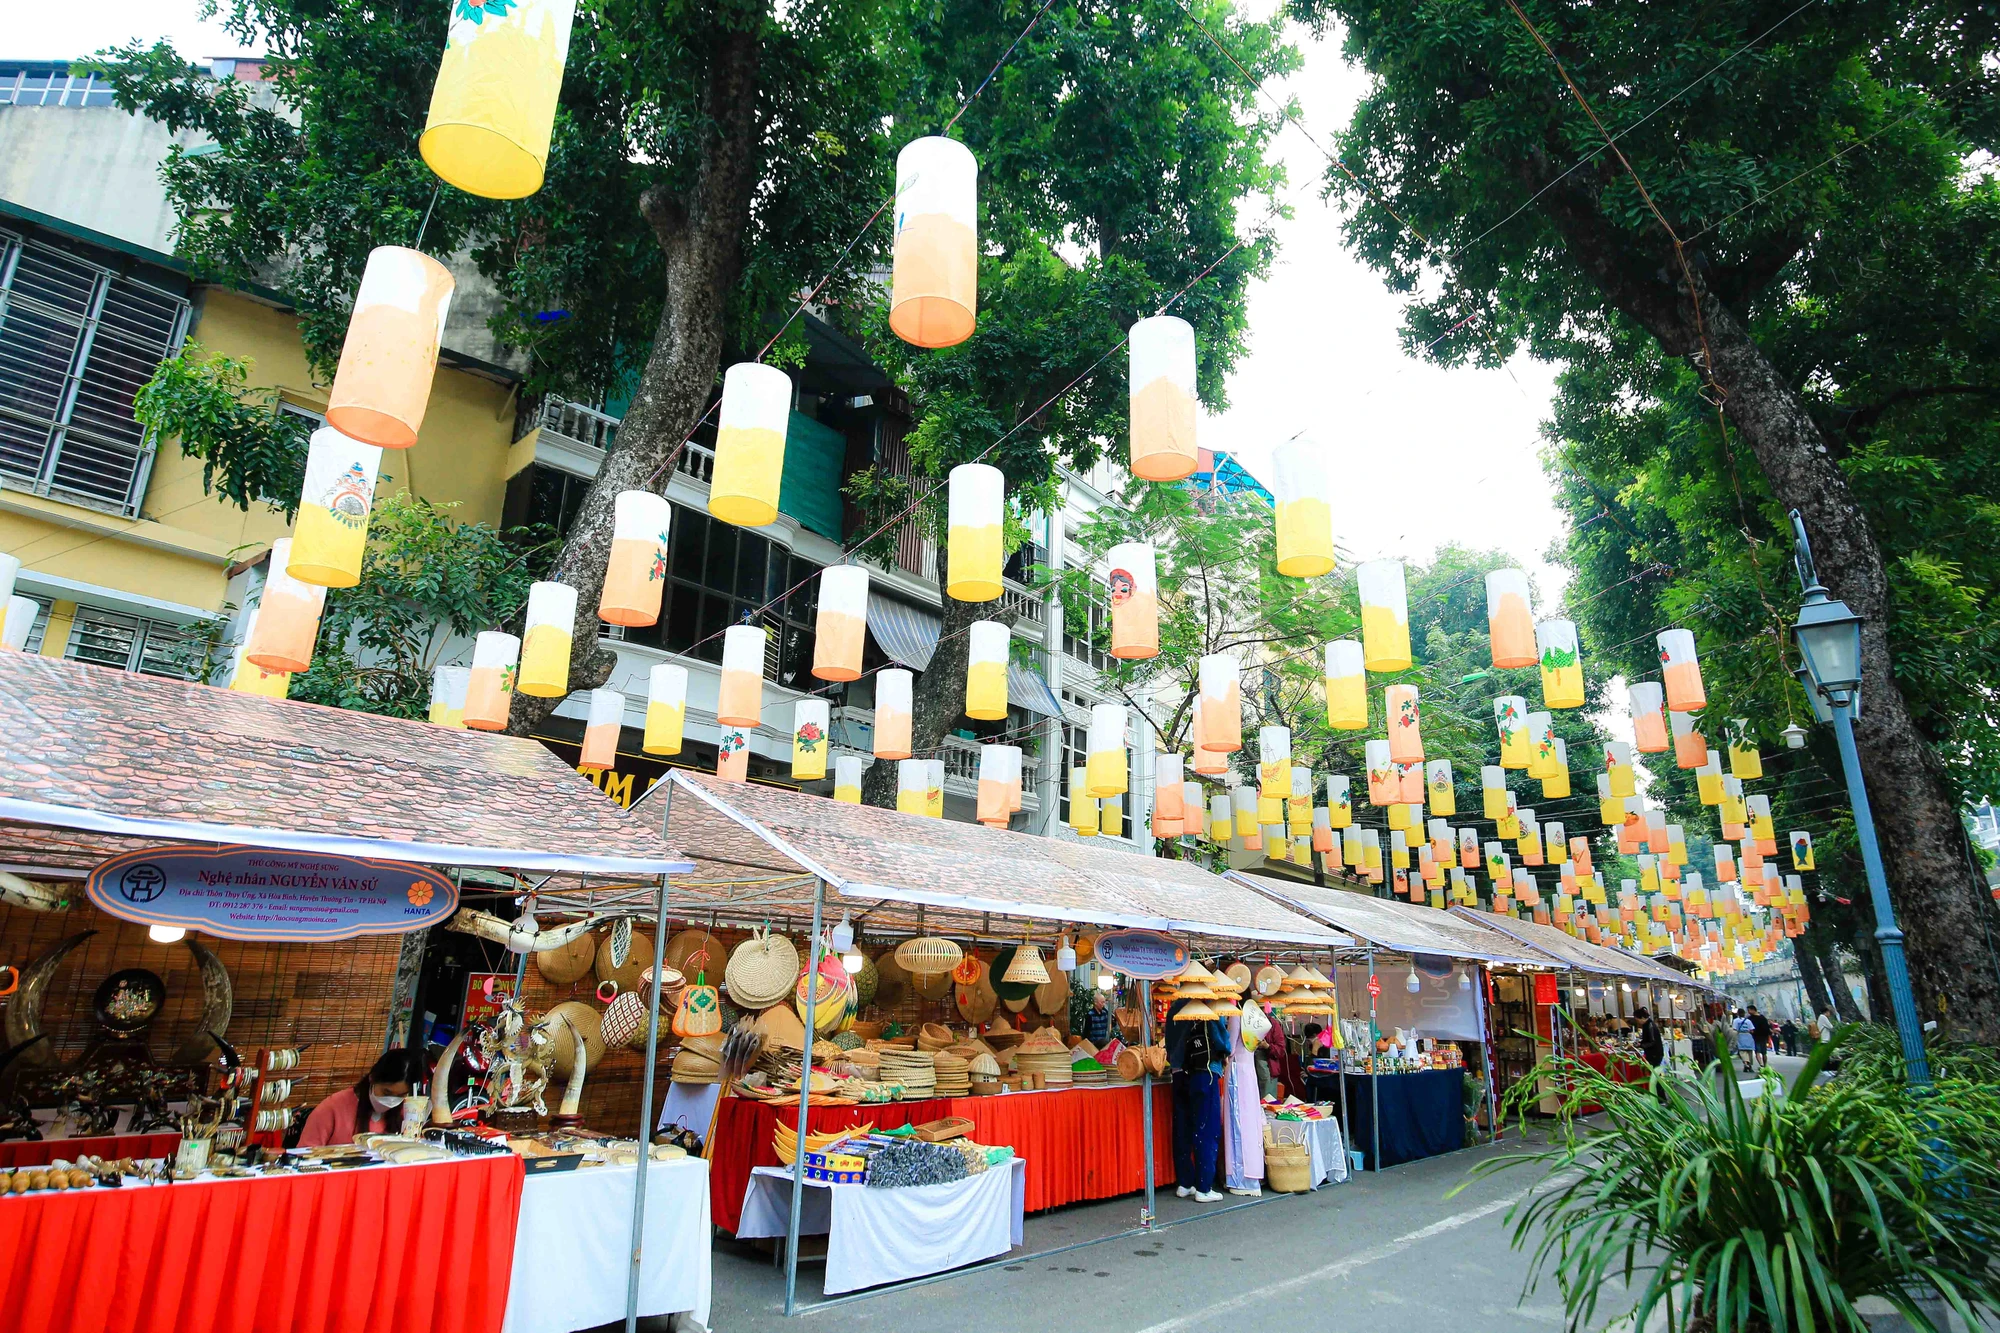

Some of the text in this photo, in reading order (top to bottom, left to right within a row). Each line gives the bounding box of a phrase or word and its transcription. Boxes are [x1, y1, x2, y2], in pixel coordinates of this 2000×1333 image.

[265, 859, 286, 868] CÔNG
[198, 870, 232, 886] Nghệ
[234, 872, 267, 885] nhân
[269, 873, 329, 889] NGUYỄN
[332, 877, 360, 890] VĂN
